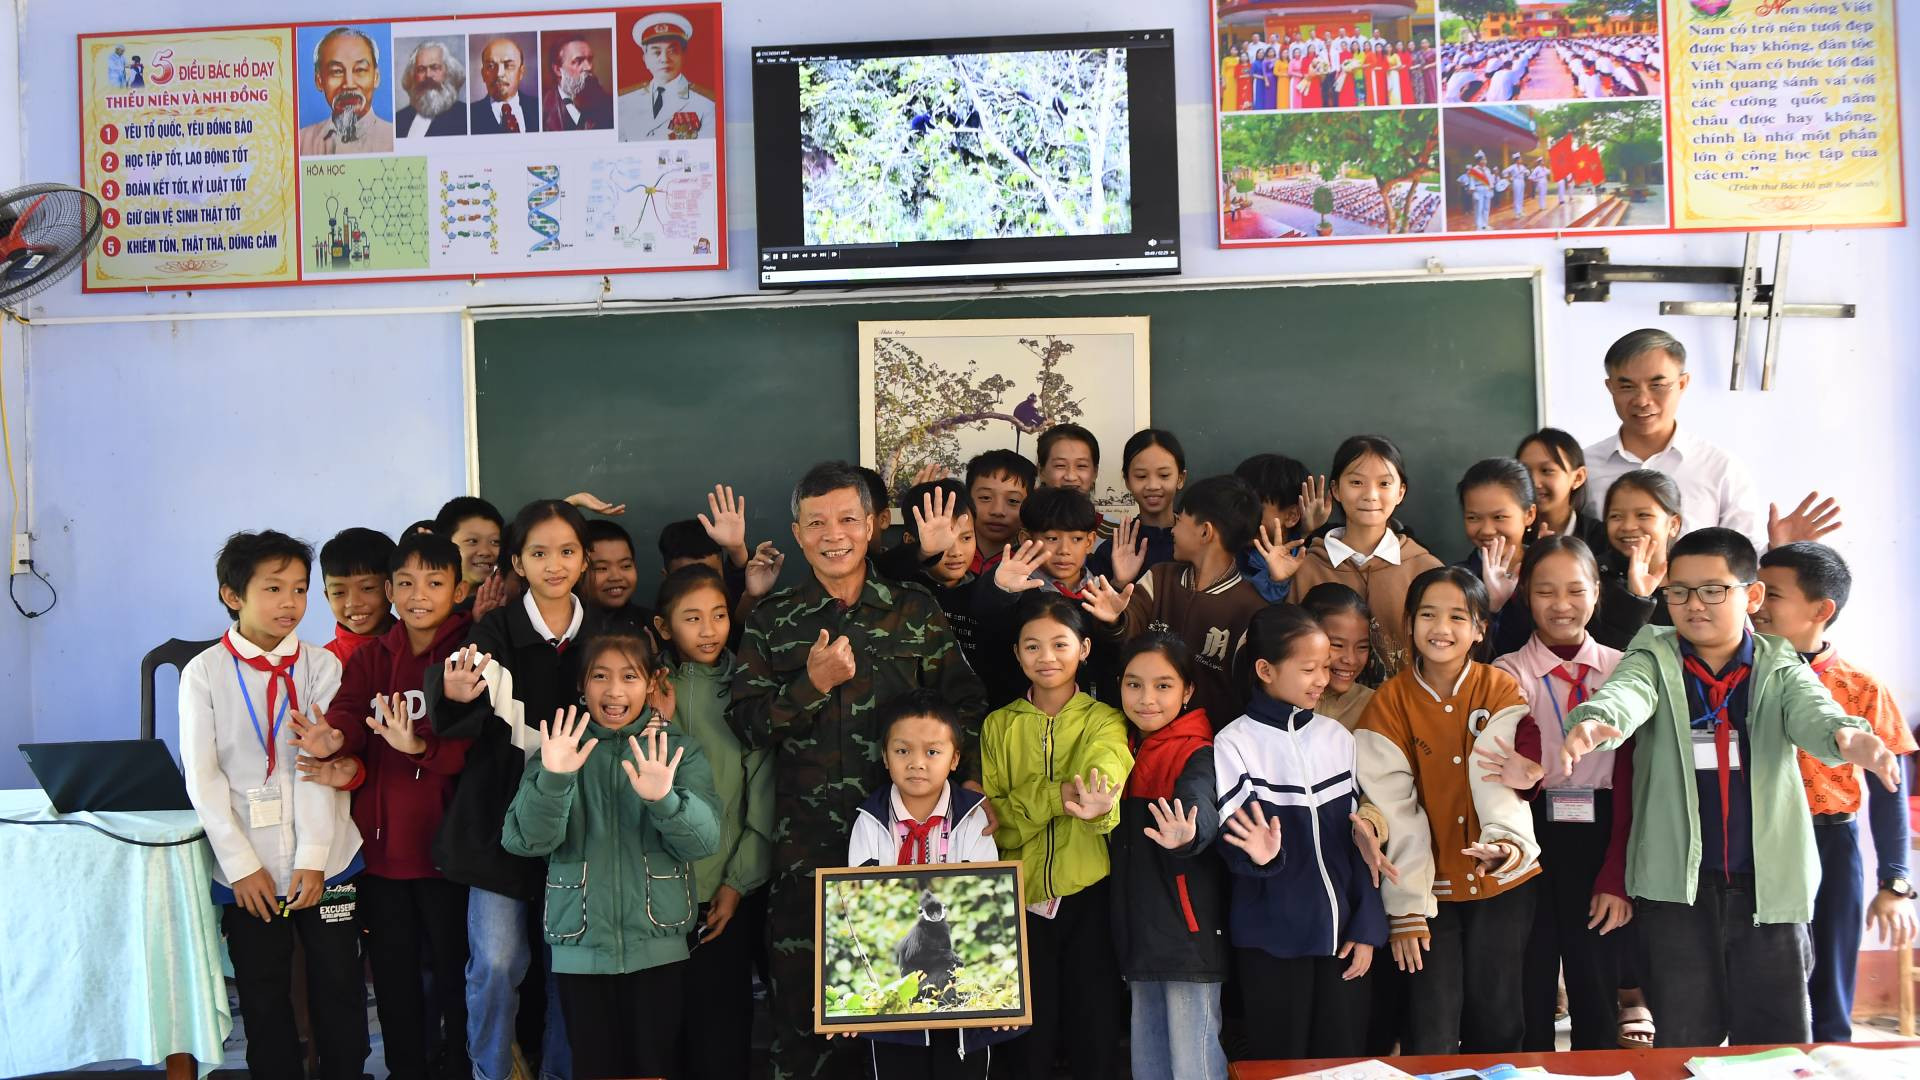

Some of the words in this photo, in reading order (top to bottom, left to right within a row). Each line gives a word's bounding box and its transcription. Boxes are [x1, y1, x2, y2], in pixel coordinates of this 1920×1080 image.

[1803, 2, 1838, 16] sông
[1842, 1, 1872, 13] Việt
[1689, 25, 1725, 36] Nam
[1729, 23, 1747, 34] có
[1752, 23, 1776, 34] trở
[1779, 22, 1806, 33] nên
[1811, 21, 1841, 32] tươi
[1845, 20, 1874, 34] đẹp
[1689, 43, 1726, 55] được
[1730, 42, 1756, 54] hay
[1818, 38, 1846, 49] dân
[1851, 37, 1874, 50] tộc
[150, 49, 175, 85] 5
[179, 59, 205, 80] ĐIỀU
[208, 60, 231, 79] BÁC
[233, 56, 249, 78] HỒ
[252, 61, 275, 80] DẠY
[1691, 60, 1721, 73] Việt
[1726, 60, 1762, 71] Nam
[1766, 58, 1783, 69] có
[1787, 57, 1822, 69] bước
[1827, 56, 1847, 67] tới
[1850, 56, 1875, 67] đài
[1691, 78, 1724, 89] vinh
[1730, 79, 1778, 91] quang
[1783, 75, 1819, 87] sánh
[1825, 75, 1847, 85] vai
[1852, 74, 1876, 84] với
[106, 90, 145, 108] THIẾU
[148, 91, 179, 107] NIÊN
[182, 89, 200, 105] VÀ
[203, 91, 227, 104] NHI
[230, 83, 268, 103] ĐỒNG
[1691, 97, 1717, 108] các
[1730, 95, 1777, 108] cường
[1790, 92, 1828, 107] quốc
[1842, 93, 1876, 103] năm
[1692, 115, 1728, 126] châu
[1739, 114, 1776, 127] được
[1786, 113, 1813, 125] hay
[104, 128, 111, 141] 1
[124, 122, 141, 139] YÊU
[187, 121, 204, 136] YÊU
[206, 117, 232, 135] ĐỒNG
[234, 117, 253, 134] BÀO
[1693, 133, 1735, 144] chính
[1743, 132, 1757, 143] là
[1765, 131, 1794, 142] nhờ
[1802, 130, 1831, 143] một
[1839, 128, 1878, 142] phần
[105, 156, 113, 169] 2
[125, 154, 143, 171] HỌC
[145, 151, 163, 170] TẬP
[165, 147, 183, 167] TỐT,
[185, 150, 203, 165] LAO
[204, 148, 230, 168] ĐỘNG
[231, 144, 249, 163] TỐT
[1693, 151, 1718, 162] lớn
[1725, 151, 1734, 161] ở
[1741, 149, 1778, 162] công
[1785, 149, 1812, 162] học
[1819, 147, 1844, 161] tập
[1851, 146, 1878, 157] của
[326, 164, 346, 177] HỌC
[1694, 169, 1718, 180] các
[106, 184, 114, 197] 3
[125, 180, 151, 196] ĐOÀN
[153, 177, 170, 195] KẾT
[172, 175, 190, 196] TỐT,
[192, 175, 204, 193] KỶ
[206, 177, 229, 196] LUẬT
[230, 173, 247, 192] TỐT
[106, 213, 114, 226] 4
[126, 208, 143, 225] GIỮ
[144, 207, 160, 224] GÌN
[162, 207, 174, 226] VỆ
[176, 208, 198, 223] SINH
[200, 205, 222, 225] THẬT
[225, 202, 242, 221] TỐT
[107, 241, 115, 254] 5
[126, 236, 156, 254] KHIÊM
[181, 234, 204, 254] THẬT
[228, 233, 254, 250] DŨNG
[256, 230, 277, 249] CẢM
